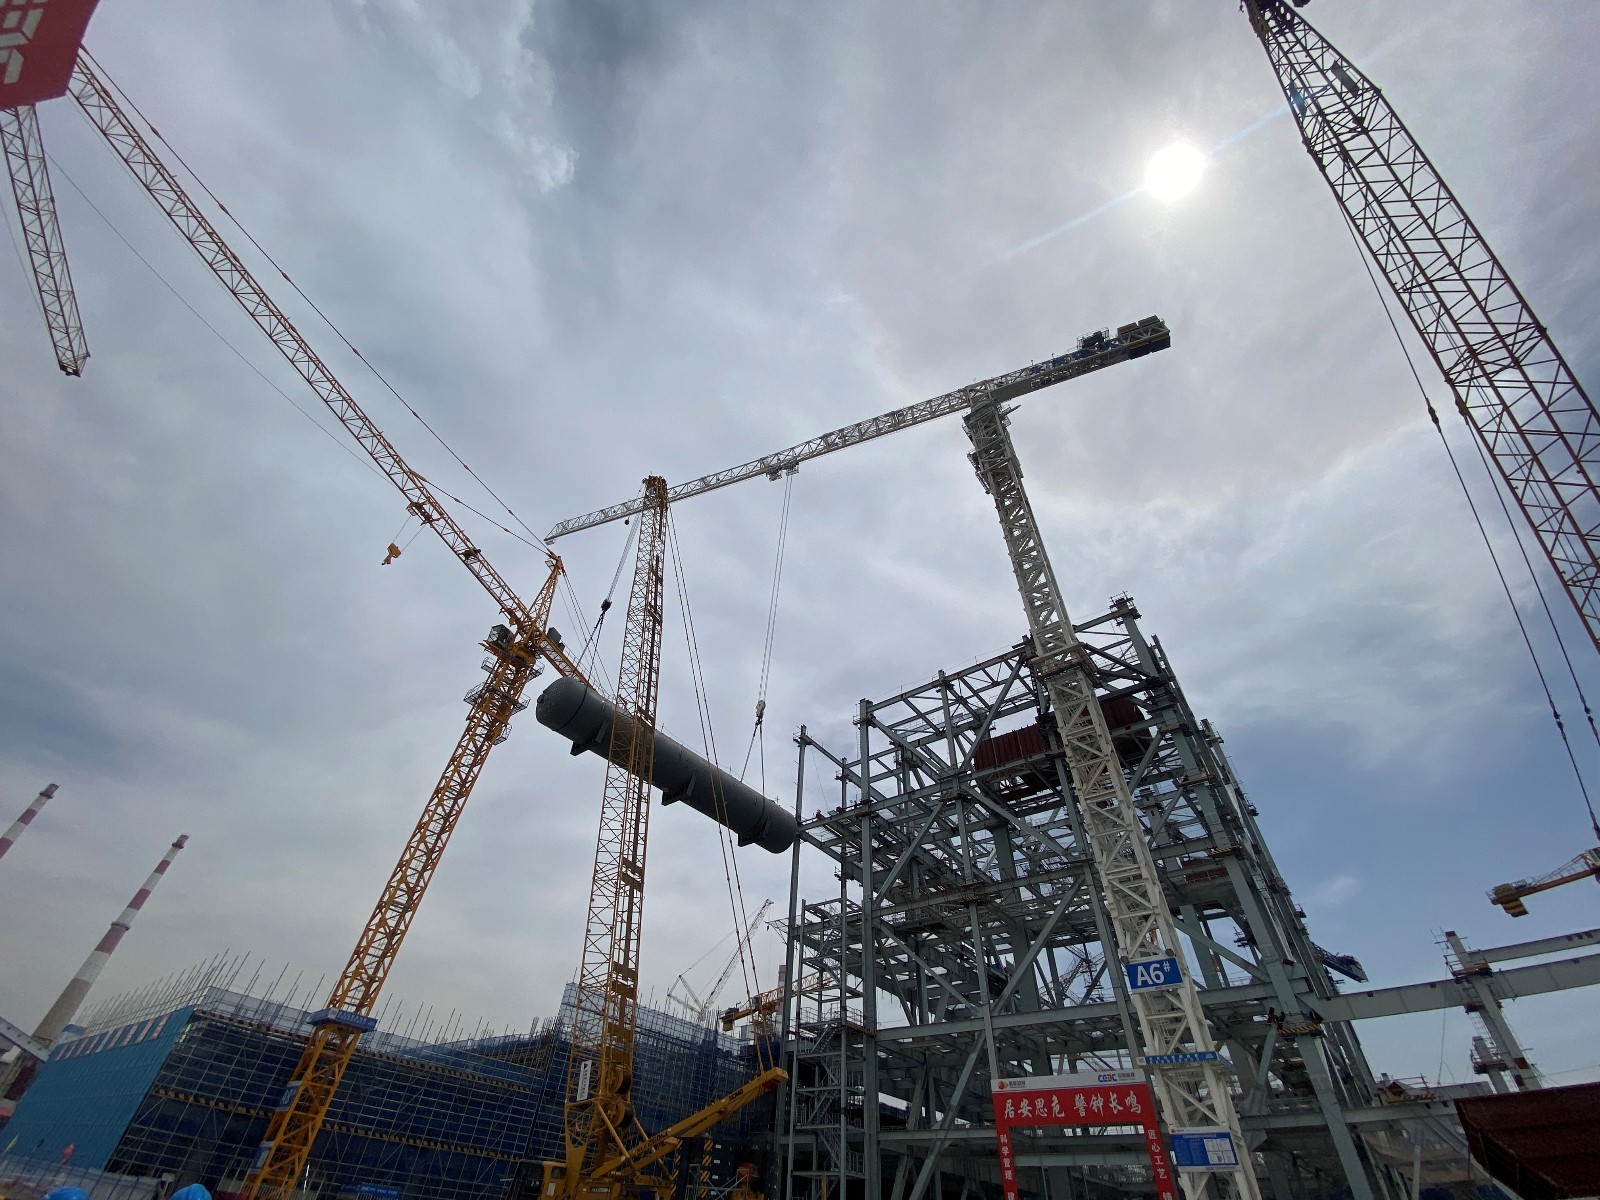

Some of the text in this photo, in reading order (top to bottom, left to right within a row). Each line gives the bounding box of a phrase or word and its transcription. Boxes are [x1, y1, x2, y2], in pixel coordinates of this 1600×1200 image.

[1137, 961, 1171, 987] A6#
[1004, 1090, 1142, 1120] 居安思危 警钟长鸣
[999, 1134, 1013, 1181] 科学管理
[1148, 1129, 1168, 1179] 匠心工艺
